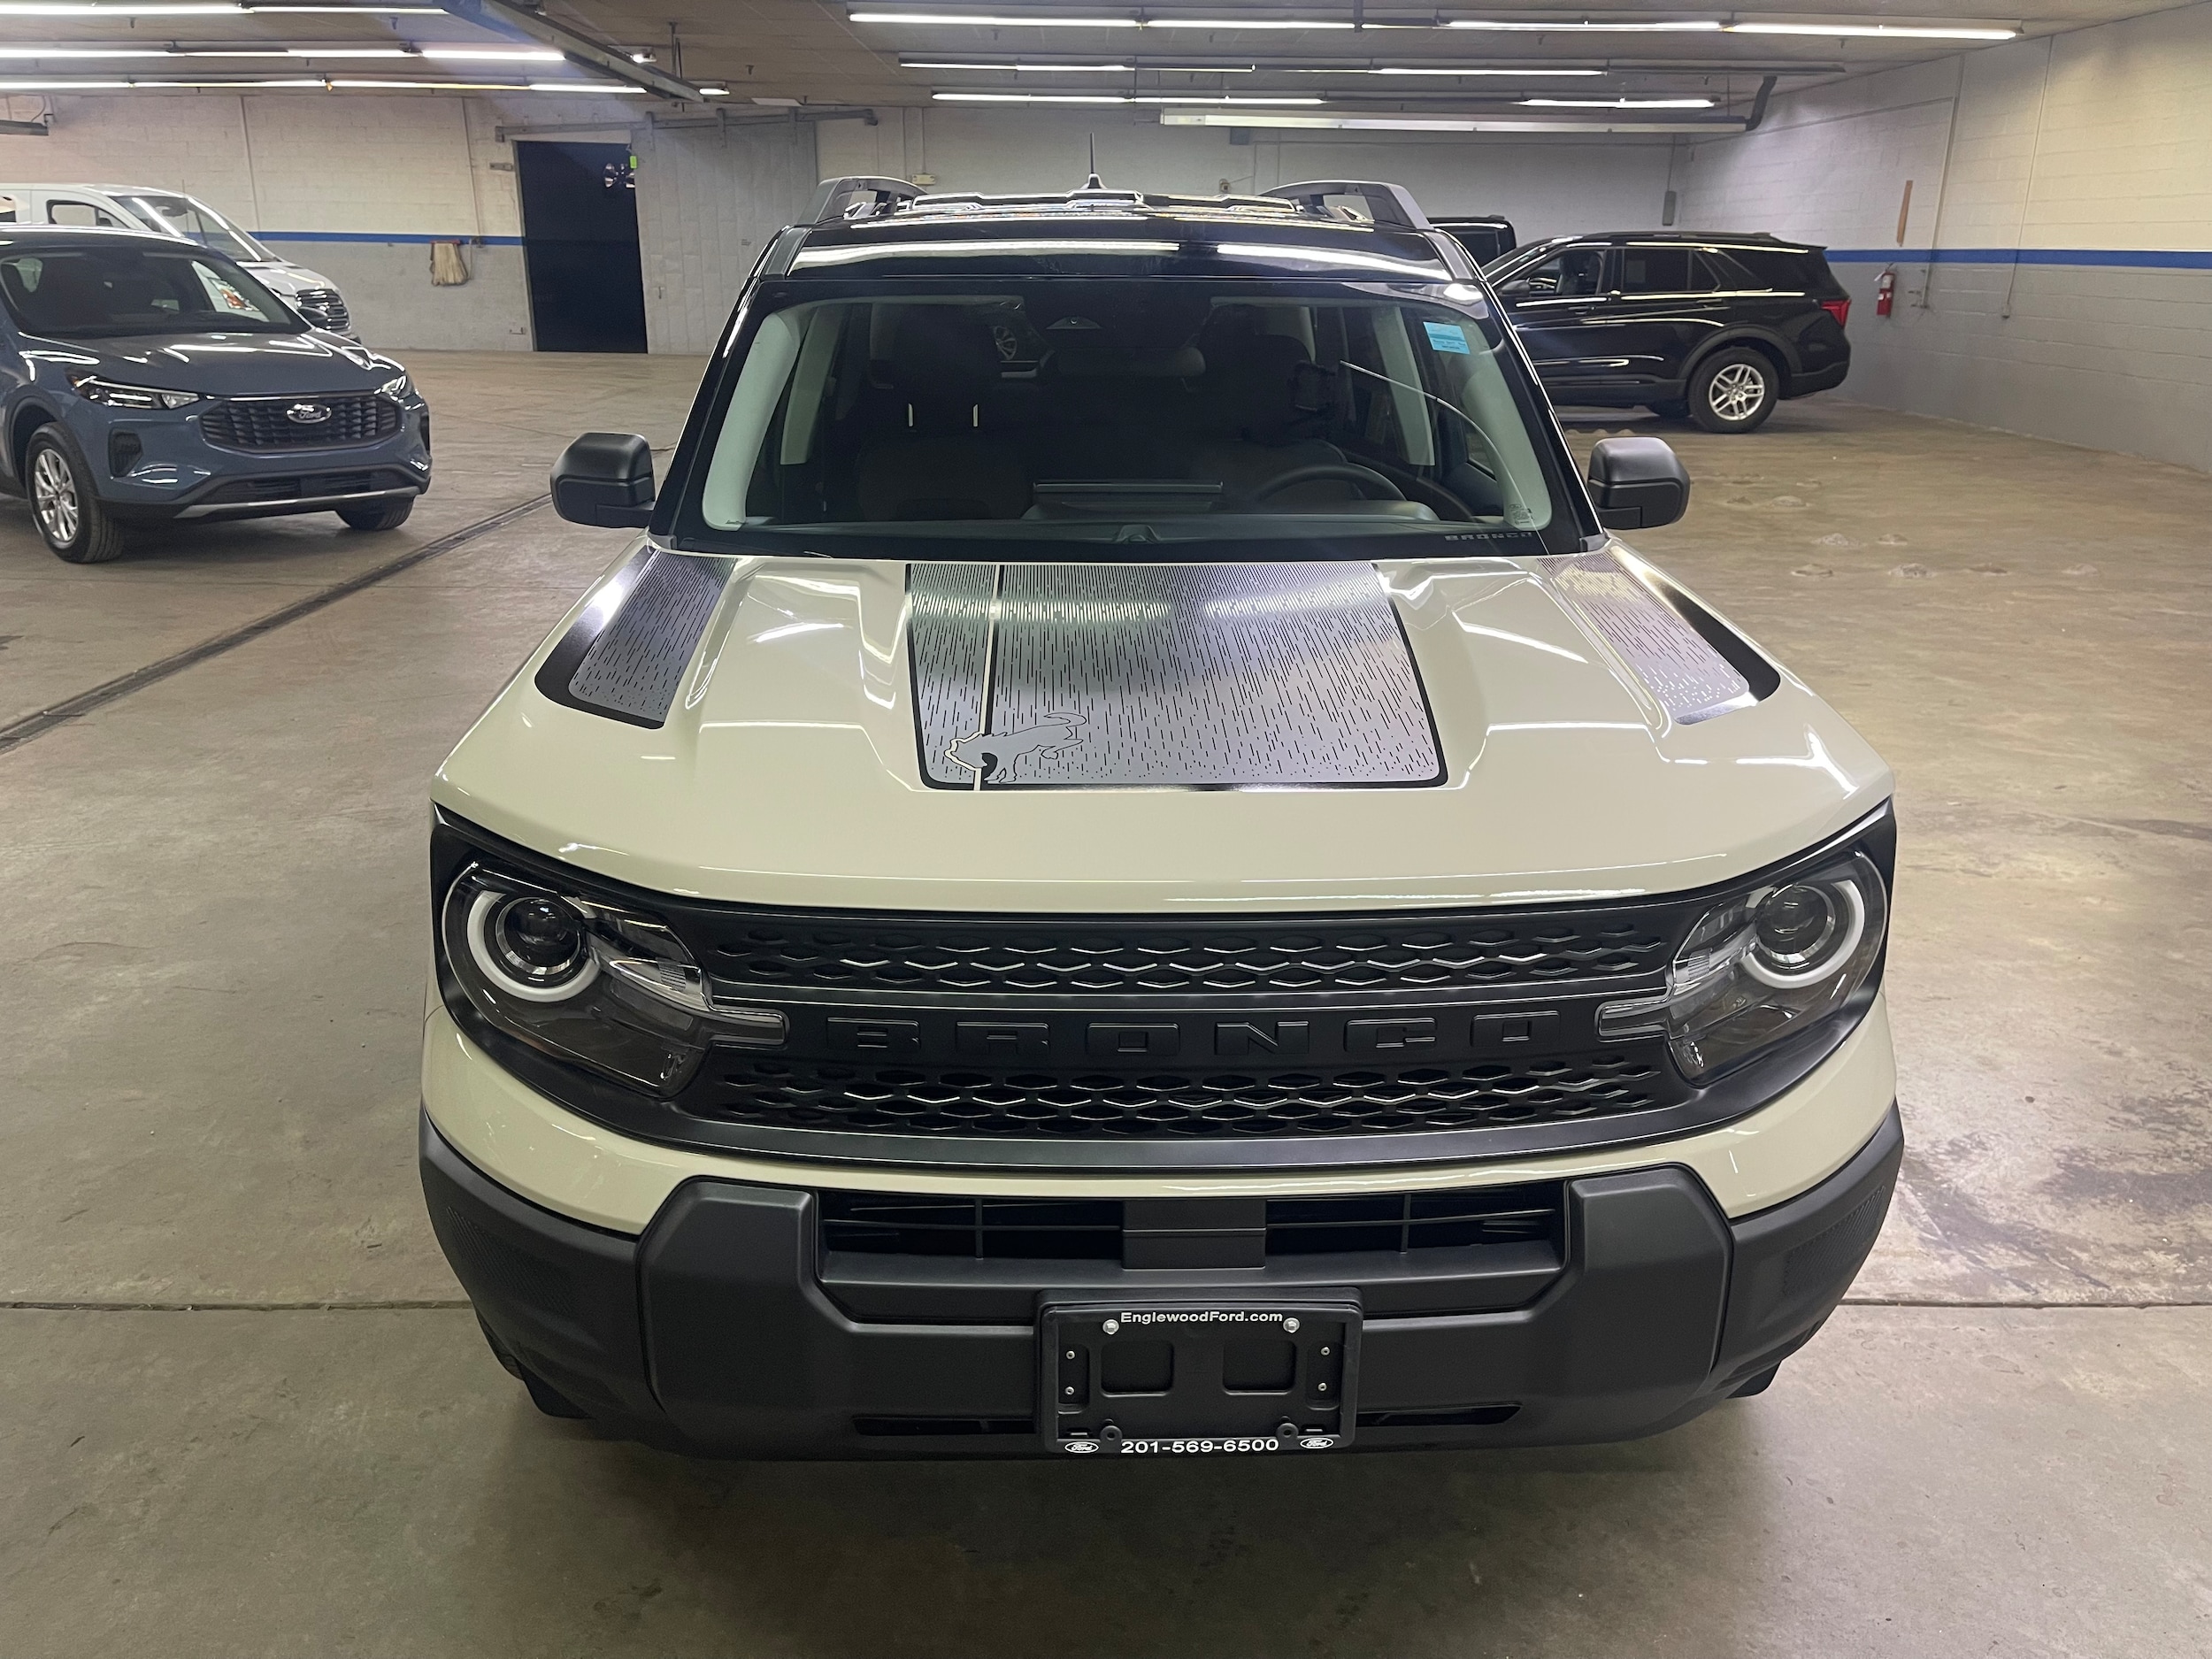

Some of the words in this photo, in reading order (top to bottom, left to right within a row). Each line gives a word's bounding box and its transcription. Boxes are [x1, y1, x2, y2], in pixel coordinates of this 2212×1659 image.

[1444, 532, 1532, 541] BRONCO
[826, 1010, 1561, 1055] BRONCO
[1120, 1311, 1283, 1325] EnglewoodFord.com
[1070, 1442, 1094, 1451] Ford
[1120, 1439, 1279, 1454] 201-569-6500
[1305, 1439, 1329, 1448] Ford
